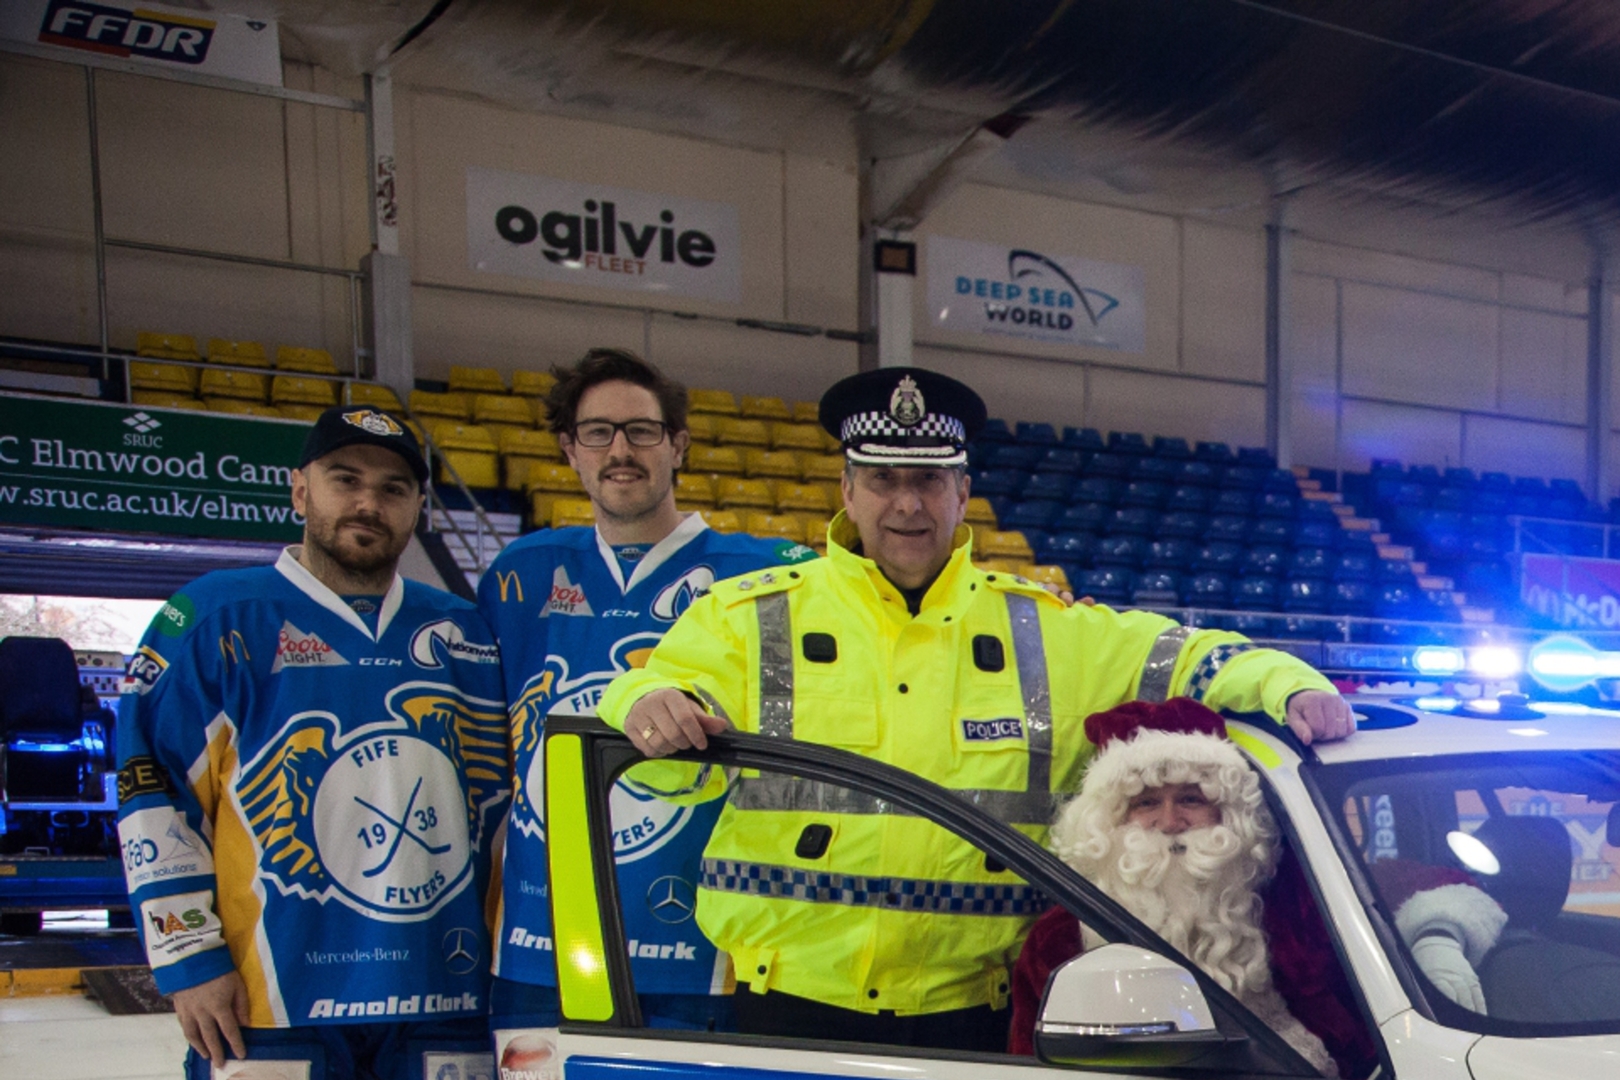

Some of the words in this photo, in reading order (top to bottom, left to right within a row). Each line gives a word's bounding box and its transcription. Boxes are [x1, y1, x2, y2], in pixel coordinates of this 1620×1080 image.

[50, 6, 205, 57] FFDR
[495, 198, 717, 268] ogilvie
[584, 253, 646, 275] FLEET
[955, 276, 1022, 300] DEEP
[1028, 287, 1075, 309] SEA
[985, 303, 1074, 330] WORLD
[123, 433, 163, 449] SRUC
[31, 438, 208, 480] Elmwood
[217, 455, 293, 487] Cam
[0, 485, 307, 526] w.sruc.ac.uk/elmwo
[278, 629, 332, 654] Coors
[283, 651, 324, 664] LIGHT
[359, 657, 402, 666] CCM
[966, 721, 1020, 738] POLICE
[350, 739, 400, 769] FIFE
[358, 823, 387, 850] 19
[413, 806, 438, 832] 38
[611, 815, 656, 847] YERS
[384, 869, 447, 904] FLYERS
[508, 926, 552, 951] Arn
[628, 942, 697, 961] lark
[304, 947, 411, 966] Mercedes-Benz
[308, 995, 421, 1019] Arnold
[424, 992, 478, 1015] Clark
